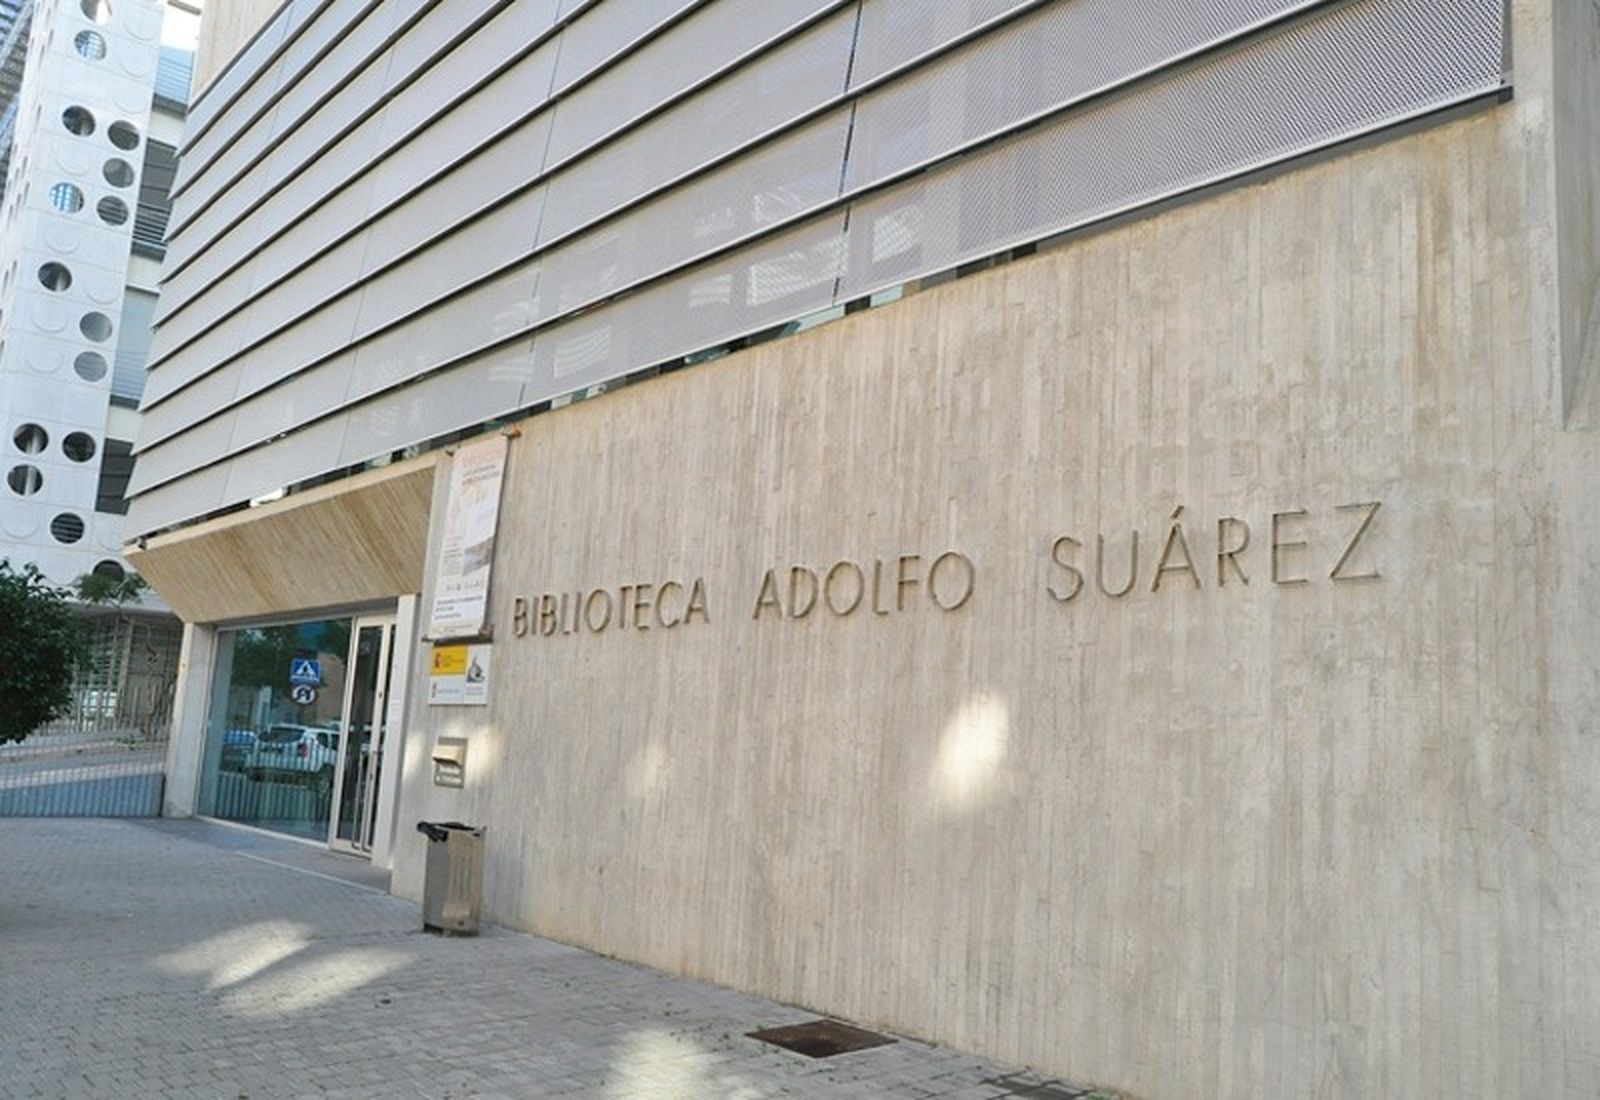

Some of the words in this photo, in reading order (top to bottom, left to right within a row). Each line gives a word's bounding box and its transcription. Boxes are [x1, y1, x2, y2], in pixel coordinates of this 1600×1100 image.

[513, 577, 710, 638] BIBLIOTECA
[752, 551, 977, 620] ADOLFO
[1046, 502, 1382, 602] SUÁREZ
